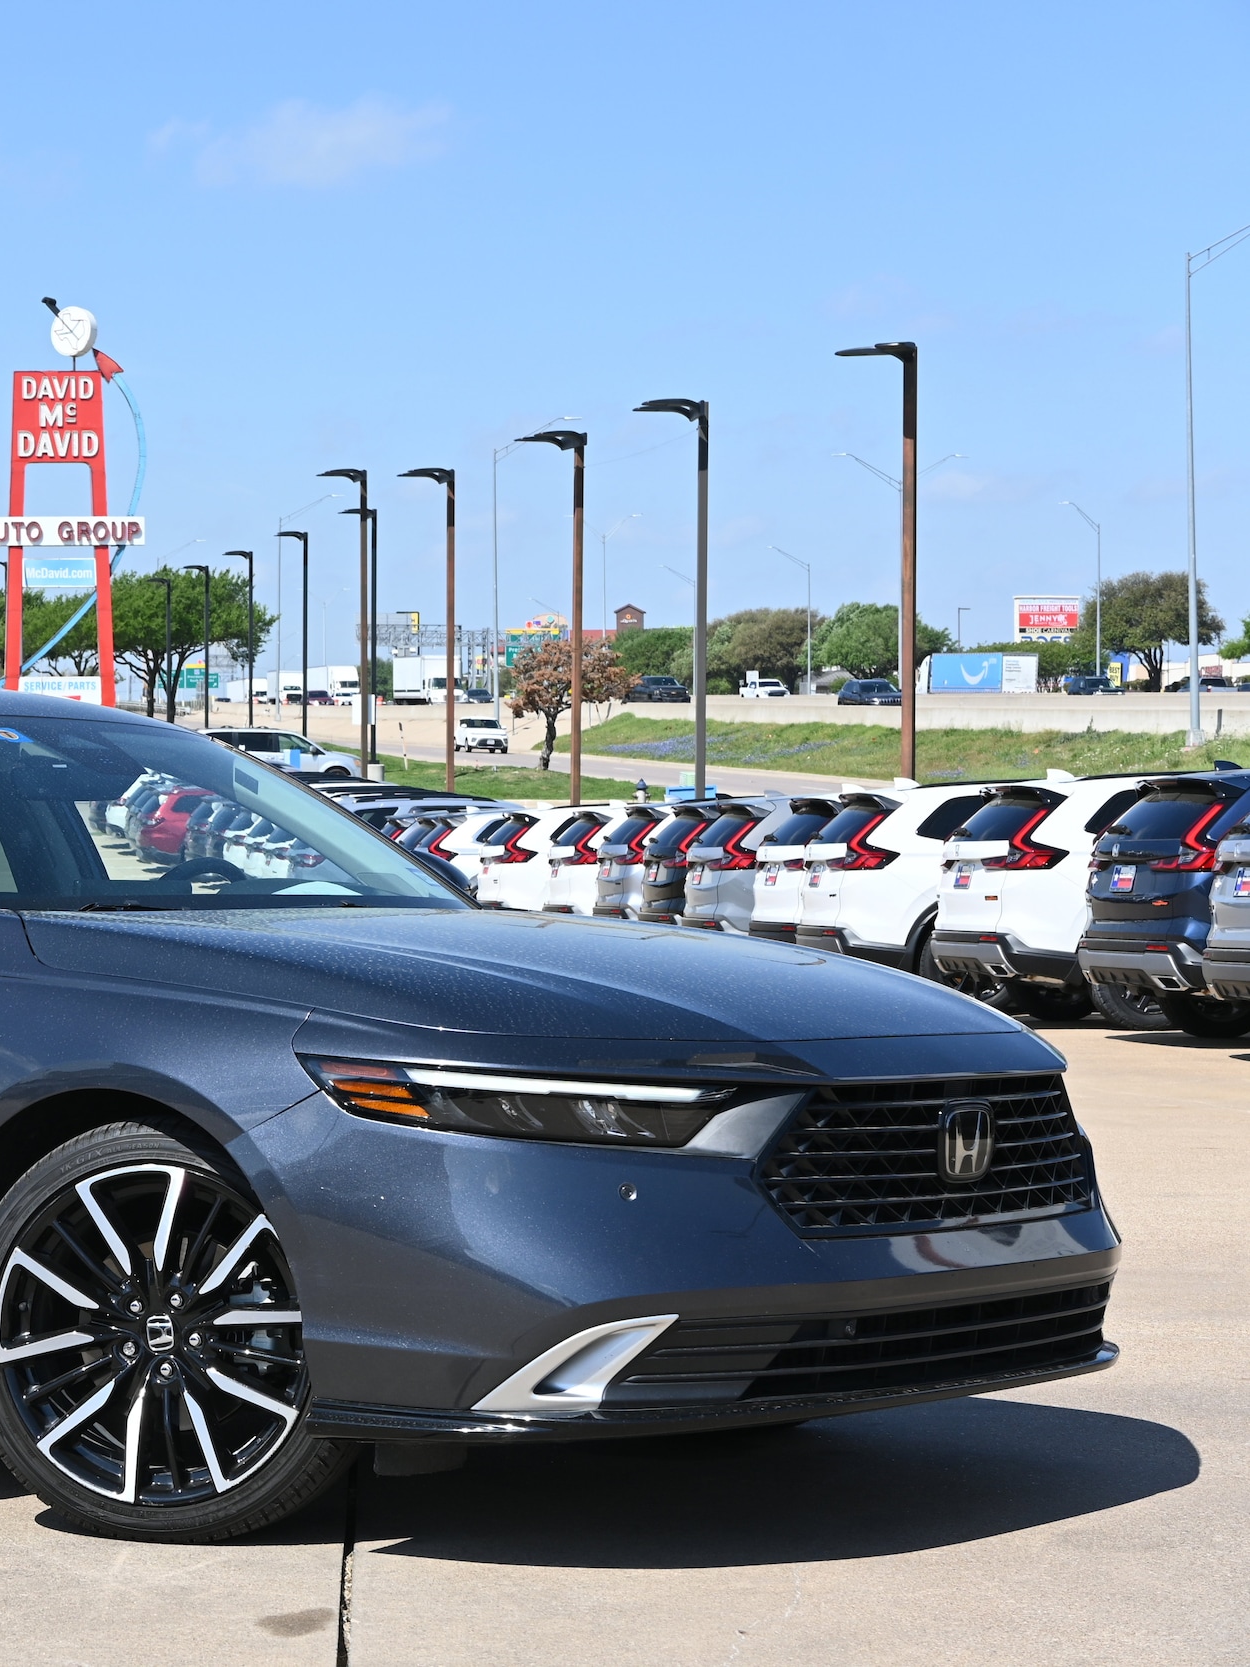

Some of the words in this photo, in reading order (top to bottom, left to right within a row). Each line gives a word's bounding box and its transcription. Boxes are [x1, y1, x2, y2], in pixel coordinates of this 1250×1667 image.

[21, 376, 94, 400] DAVID
[17, 430, 99, 458] DAVID
[57, 521, 142, 543] GROUP
[26, 567, 93, 580] McDavid.com
